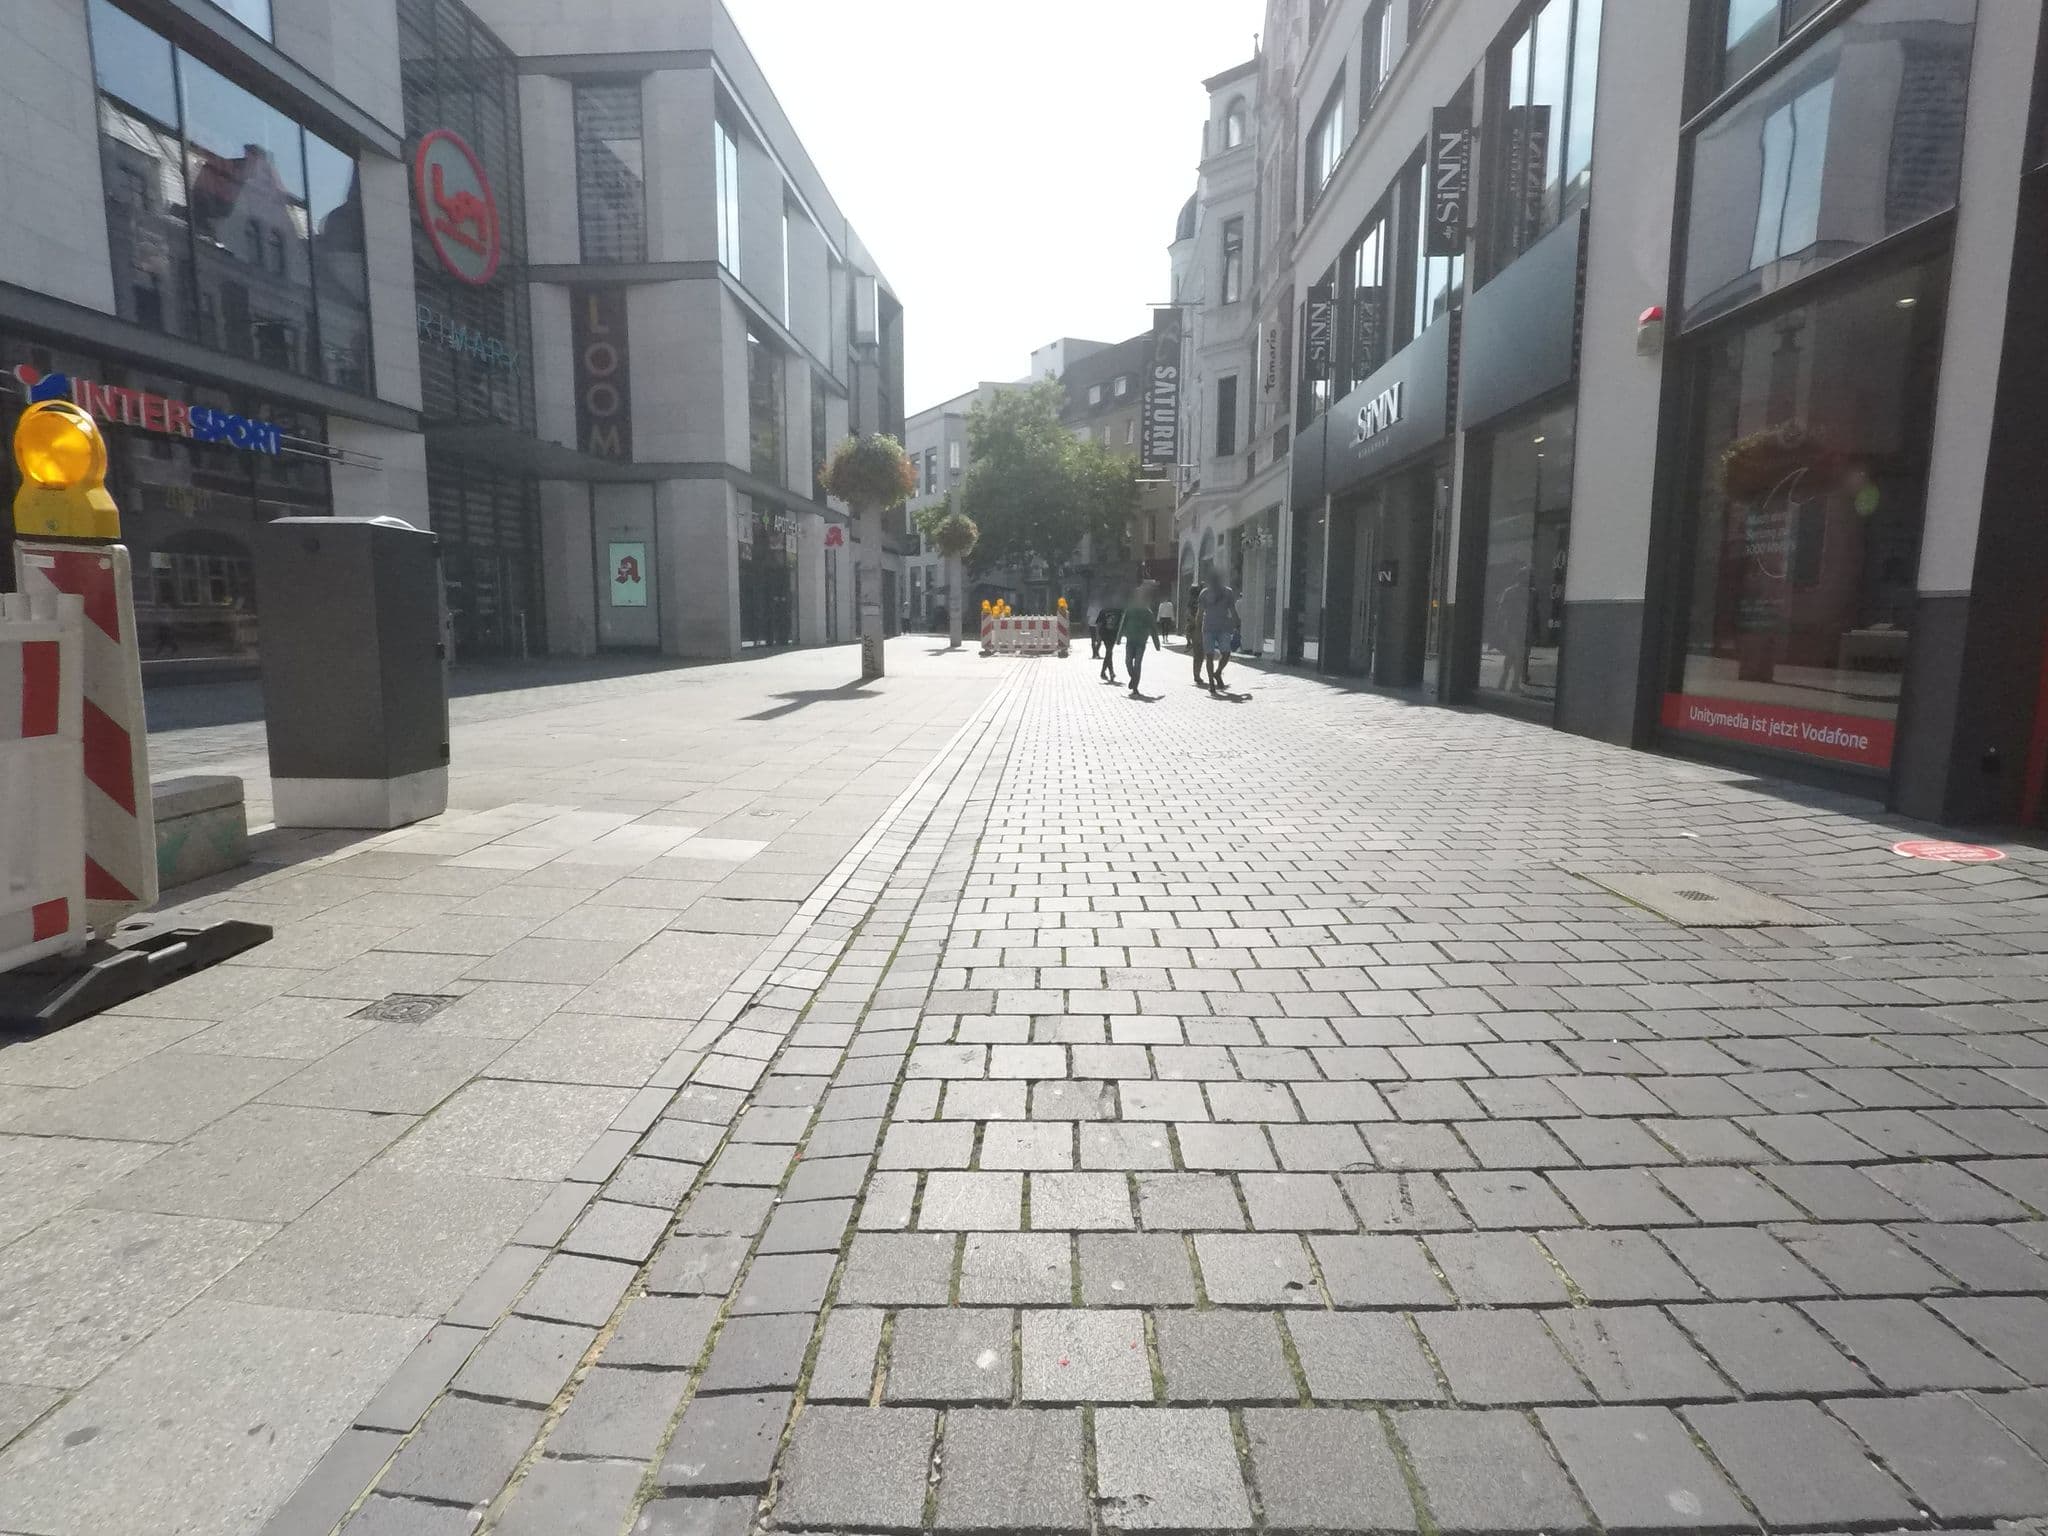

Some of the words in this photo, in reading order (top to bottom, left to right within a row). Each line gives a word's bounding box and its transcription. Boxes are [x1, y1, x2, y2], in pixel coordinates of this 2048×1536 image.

[1437, 133, 1462, 223] SiNN
[417, 304, 521, 377] RIMARK
[1311, 303, 1327, 360] SiNN
[584, 294, 622, 456] LOOM
[1153, 366, 1177, 456] SATURN
[1357, 381, 1403, 444] SiNN
[71, 376, 282, 455] INTERSPORT
[1689, 706, 1749, 729] Unitymedia
[1751, 714, 1767, 733] ist
[1768, 717, 1799, 738] jetzt
[1801, 721, 1868, 750] Vodafone
